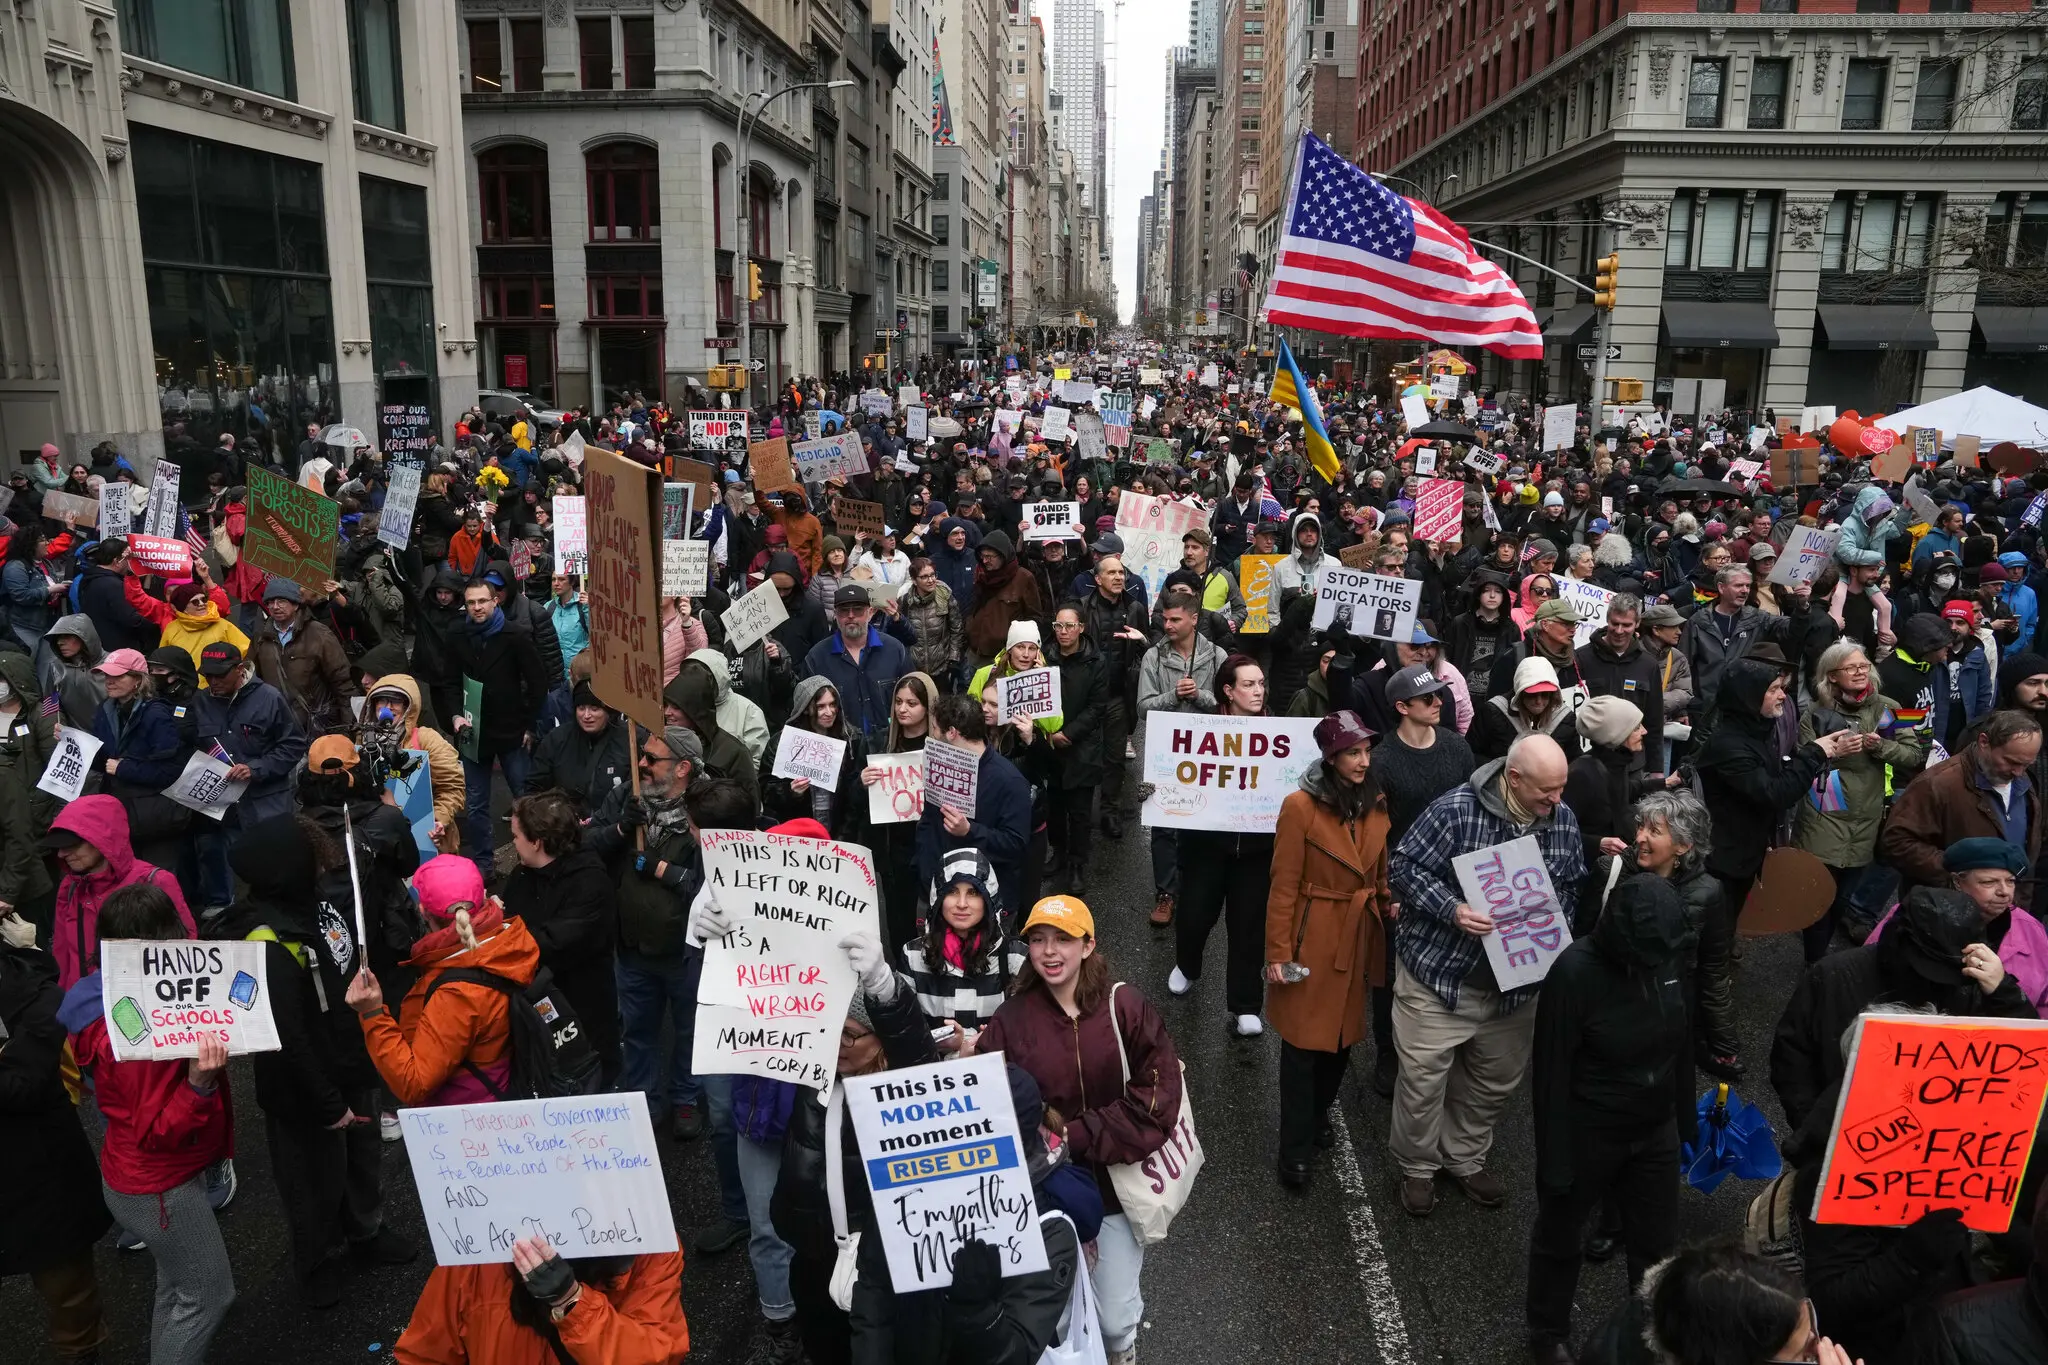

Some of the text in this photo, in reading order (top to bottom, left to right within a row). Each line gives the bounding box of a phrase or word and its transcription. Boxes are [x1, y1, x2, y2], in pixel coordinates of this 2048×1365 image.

[717, 340, 724, 348] 26
[409, 406, 427, 414] OUR
[1100, 392, 1132, 411] STOP
[690, 412, 744, 421] TURD REICH
[392, 427, 417, 439] NOT
[706, 422, 728, 436] NO!
[1864, 432, 1894, 441] PROTECT
[758, 453, 779, 465] HANDS
[795, 446, 842, 462] MEDICAID
[1474, 455, 1496, 470] OFF!
[1477, 449, 1498, 463] HANDS
[106, 488, 123, 499] PEOPLE
[1417, 480, 1435, 495] LIAR
[106, 501, 120, 514] HAVE
[107, 514, 120, 524] THE
[250, 487, 321, 538] FORESTS
[1033, 504, 1070, 513] HANDS
[1034, 512, 1070, 527] OFF!
[1117, 496, 1208, 533] HATE
[1418, 493, 1454, 524] RAPIST
[108, 525, 130, 538] POWER!
[562, 516, 574, 527] IS
[1420, 508, 1455, 540] RACIST
[1438, 523, 1460, 542] FRAUD
[135, 541, 182, 552] STOP THE
[594, 509, 640, 568] SILENCE
[673, 544, 685, 554] you
[686, 544, 698, 552] can
[698, 544, 708, 552] read
[1803, 532, 1834, 554] NONE
[140, 560, 181, 571] TAKEOVER
[561, 550, 588, 560] HANDS
[677, 553, 692, 562] fund
[1800, 554, 1813, 564] OF
[679, 578, 690, 587] you
[694, 565, 704, 576] And
[1788, 568, 1800, 578] IS
[614, 560, 641, 616] NOT
[1326, 572, 1405, 594] STOP THE
[1576, 583, 1603, 600] YOUR
[745, 598, 767, 622] ANY
[1322, 588, 1412, 612] DICTATORS
[588, 590, 647, 652] PROTECT
[736, 616, 771, 640] of this
[624, 653, 635, 694] A
[1008, 672, 1048, 690] HANDS
[1010, 683, 1048, 704] OFF!
[1006, 700, 1052, 719] SCHOOLS
[794, 734, 833, 753] HANDS
[1172, 728, 1290, 758] HANDS
[56, 755, 82, 778] FREE
[790, 744, 832, 768] OFF!
[188, 768, 212, 798] HANDS
[784, 760, 830, 784] SCHOOLS
[880, 764, 923, 791] HAN
[930, 762, 970, 782] HANDS
[931, 772, 970, 794] OFF!
[1176, 760, 1259, 790] OFF!!
[196, 772, 222, 801] OFF!
[204, 776, 230, 806] HOUSING
[702, 831, 754, 850] HANDS
[766, 834, 794, 846] OFF
[798, 838, 810, 846] the
[782, 849, 800, 868] IS
[806, 854, 848, 874] NOT
[712, 866, 871, 914] A LEFT OR RIGHT
[754, 901, 834, 932] MOMENT.
[1474, 850, 1539, 968] TROUBLE
[1512, 868, 1560, 952] GOOD
[722, 926, 771, 956] IT'S A
[142, 946, 224, 976] HANDS
[736, 963, 828, 987] RIGHT OR
[155, 976, 211, 1002] OFF
[746, 992, 826, 1018] WRONG
[151, 1009, 234, 1027] SCHOOLS
[766, 1056, 809, 1080] CORY
[1894, 1040, 2048, 1074] HANDS
[870, 1072, 979, 1103] This is a
[1918, 1075, 2010, 1105] OFF
[408, 1101, 632, 1137] The American Government
[880, 1094, 980, 1127] MORAL
[429, 1145, 446, 1161] is
[460, 1138, 490, 1158] By
[497, 1136, 521, 1154] the
[570, 1129, 608, 1148] For
[879, 1118, 994, 1152] moment
[1856, 1115, 1918, 1153] OUR
[1921, 1128, 2030, 1169] FREE
[437, 1164, 466, 1181] the
[521, 1159, 547, 1175] and
[582, 1152, 612, 1170] the
[608, 1146, 654, 1170] People
[892, 1148, 992, 1180] RISE UP
[444, 1184, 489, 1208] AND
[893, 1173, 1033, 1242] Empathy
[438, 1206, 643, 1257] We Are The People!
